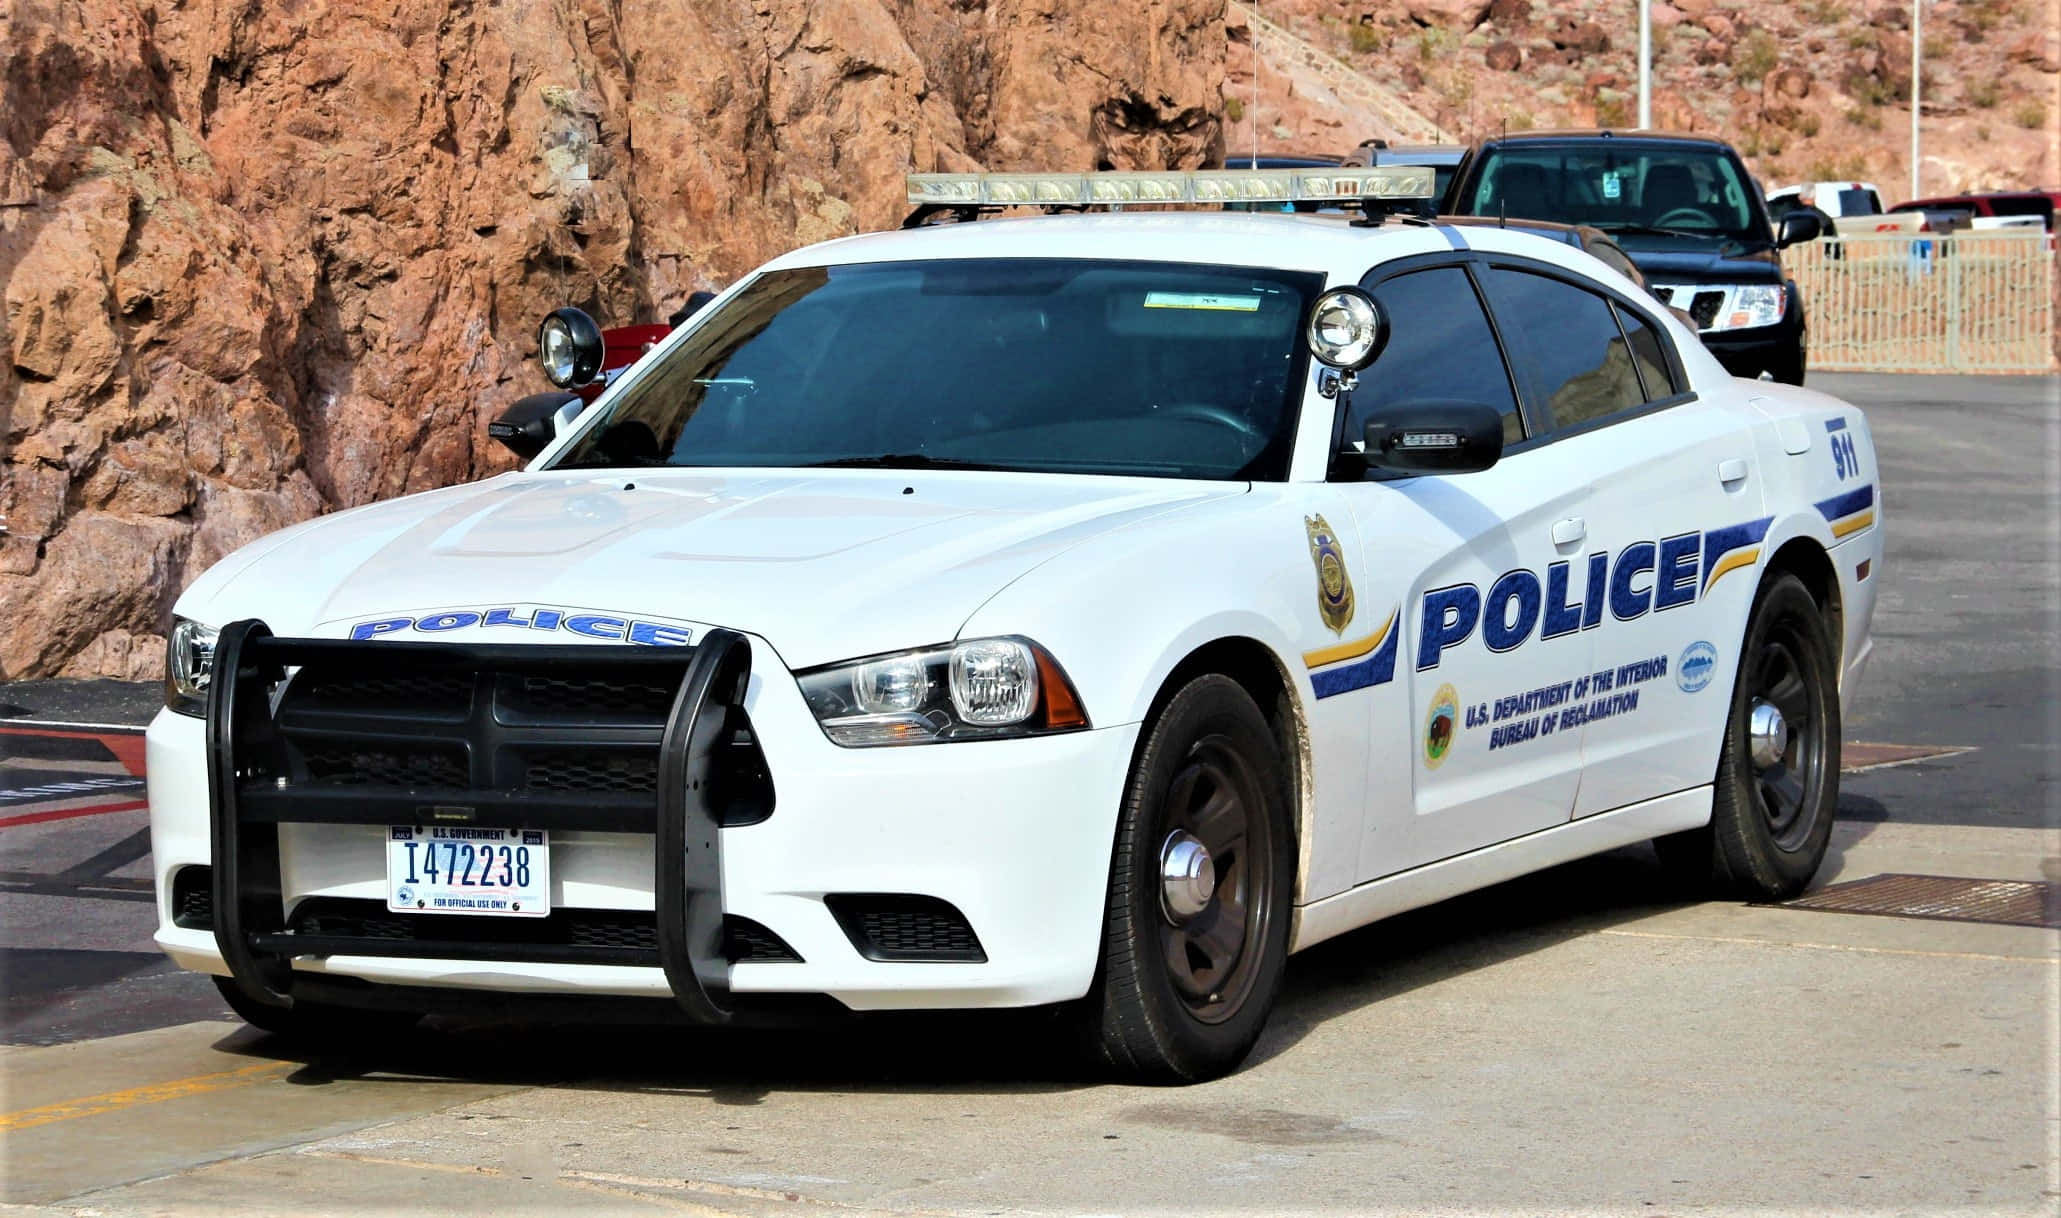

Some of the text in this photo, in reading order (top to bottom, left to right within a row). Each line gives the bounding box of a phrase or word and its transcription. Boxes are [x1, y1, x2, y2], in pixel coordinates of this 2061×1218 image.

[1830, 431, 1859, 481] 911
[1416, 530, 1701, 673] POLICE
[349, 608, 694, 646] POLICE
[1466, 703, 1489, 729] U.S.
[1493, 680, 1573, 722] DEPARTMENT
[1574, 675, 1590, 699] OF
[1592, 668, 1613, 694] THE
[1616, 655, 1668, 688] INTERIOR
[1489, 690, 1639, 750] BUREAU OF RECLAMATION
[433, 827, 505, 840] U.S. GOVERNMENT
[404, 842, 530, 888] I472238
[434, 898, 507, 909] FOR OFFICIAL USE ONLY
